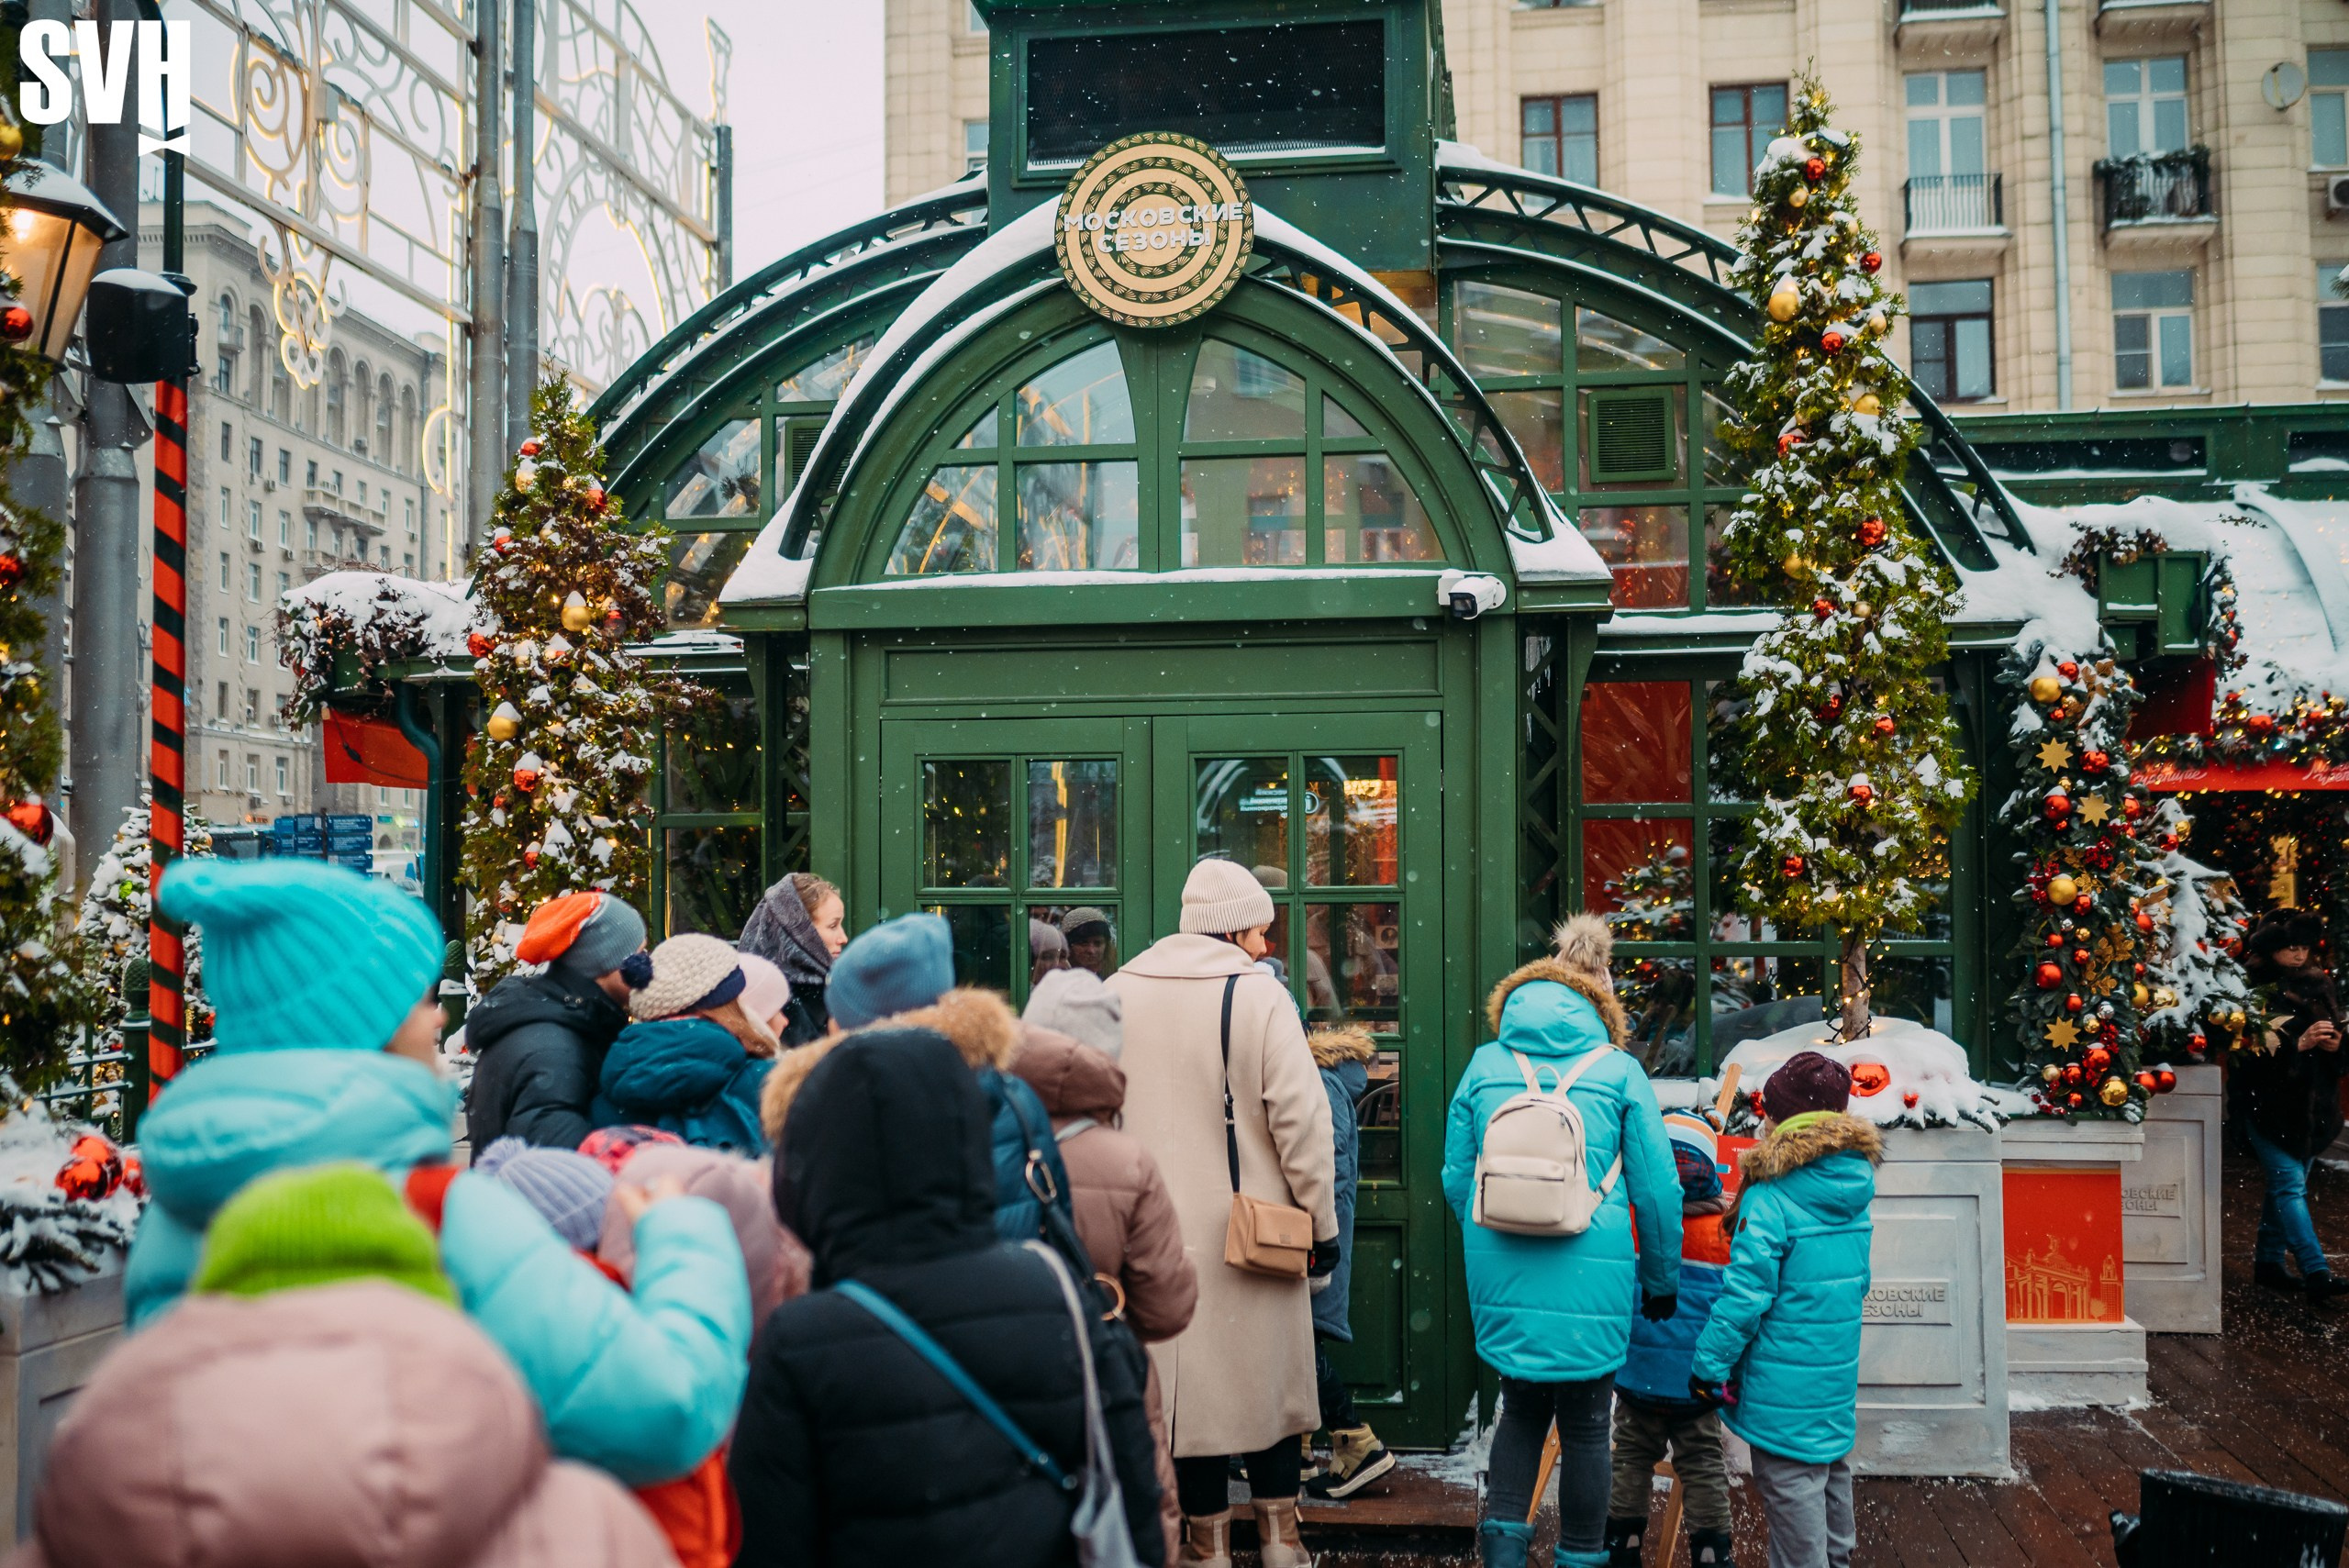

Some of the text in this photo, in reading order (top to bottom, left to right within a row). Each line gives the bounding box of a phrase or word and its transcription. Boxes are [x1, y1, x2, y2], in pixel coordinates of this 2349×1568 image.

[1063, 203, 1243, 232] МОСКОВСКИЕ
[1097, 228, 1210, 253] СЕЗОНЫ
[2121, 1188, 2176, 1200] ОВСКИЕ
[1864, 1286, 1945, 1302] КОВСКИЕ
[1862, 1303, 1923, 1318] ЕЗОНЫ
